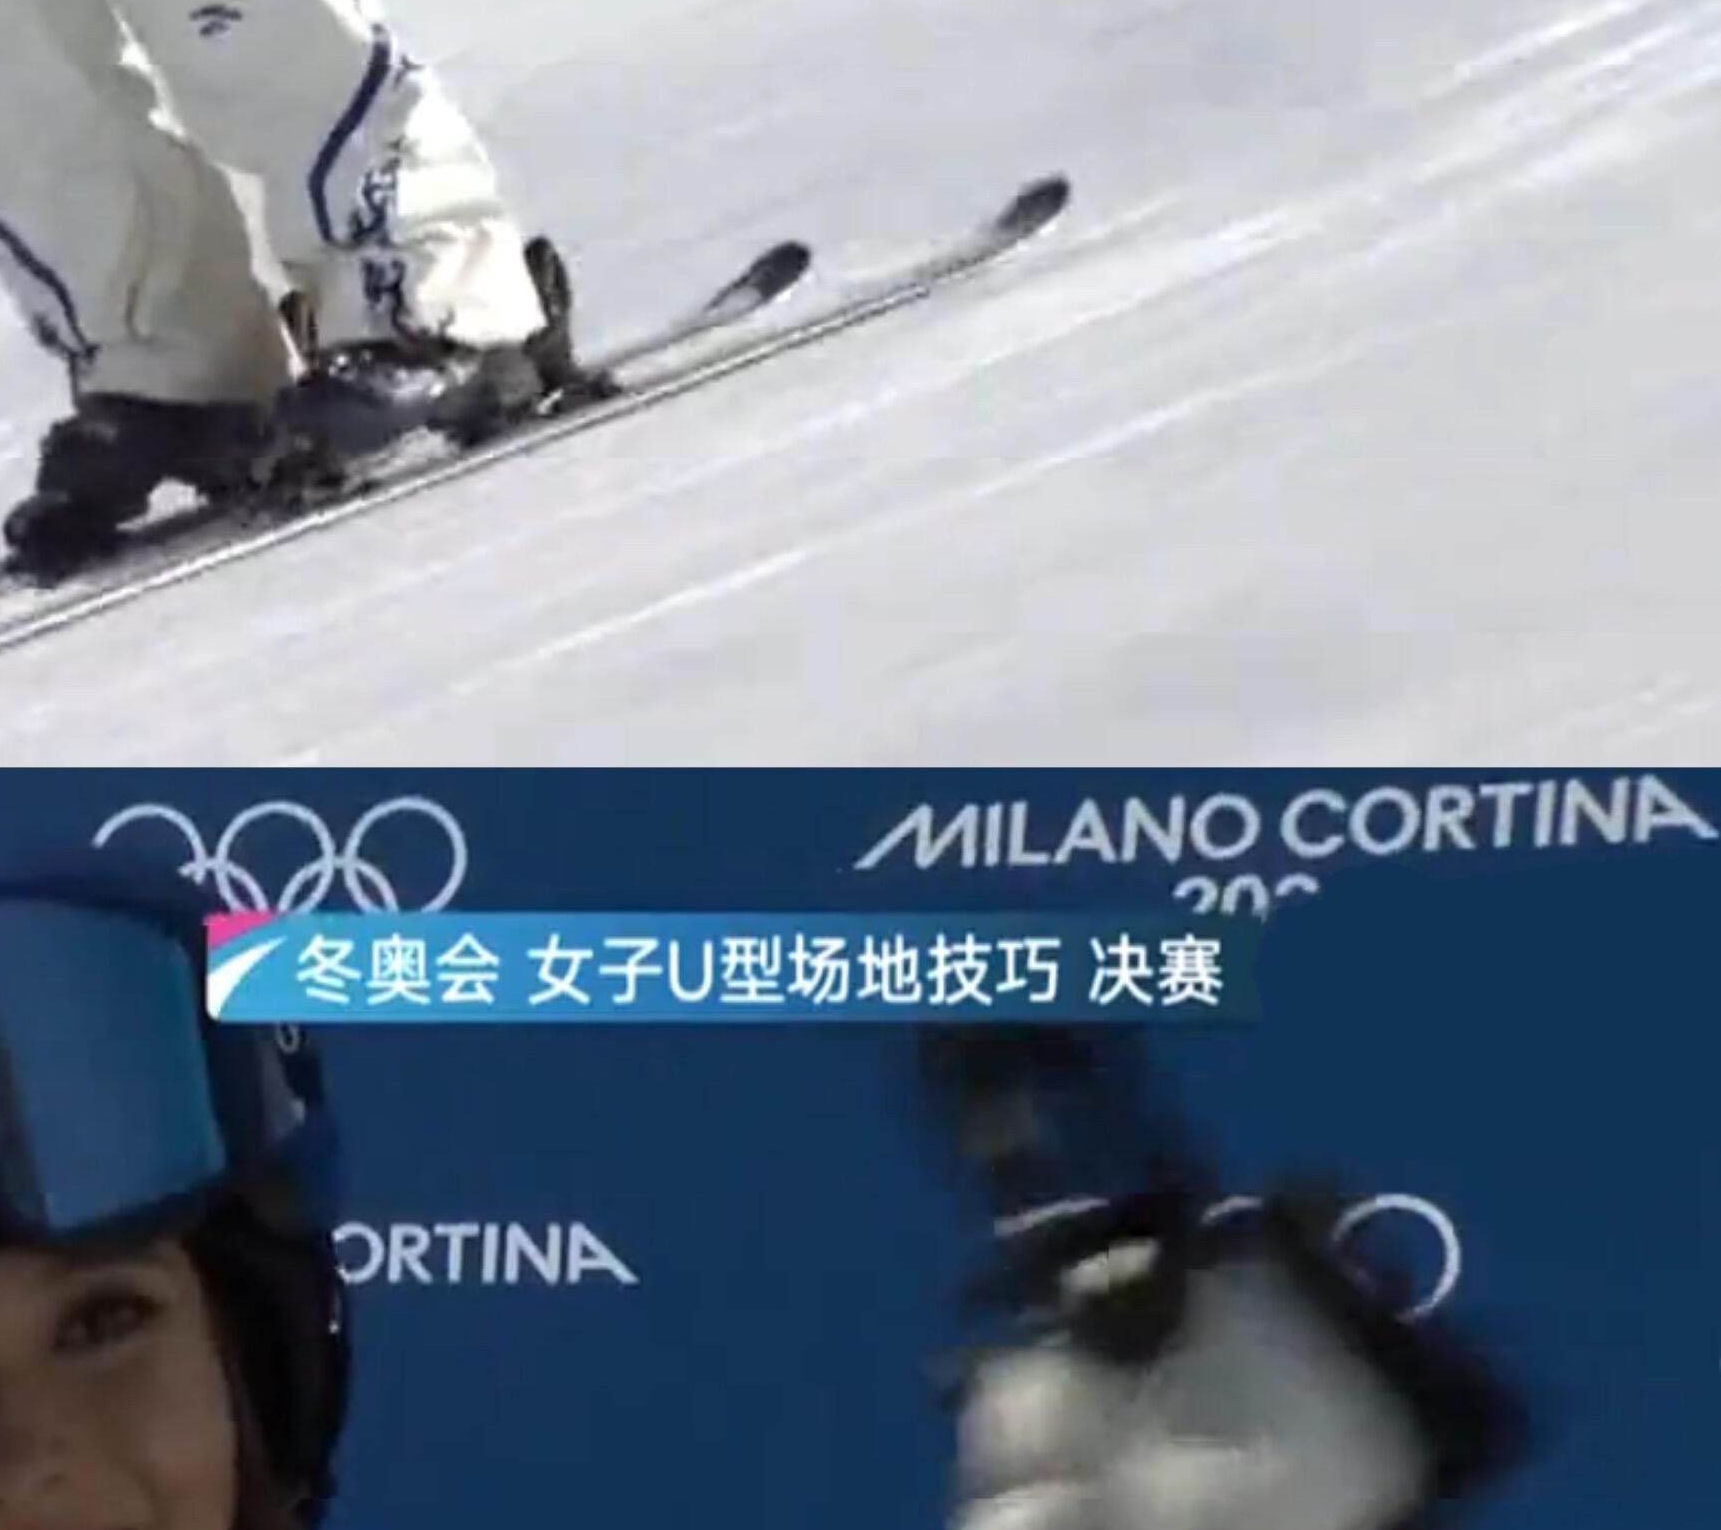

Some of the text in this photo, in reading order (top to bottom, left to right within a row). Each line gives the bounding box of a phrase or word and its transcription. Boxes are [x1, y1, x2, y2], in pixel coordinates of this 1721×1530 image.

[854, 774, 1719, 870] MILANO CORTINA
[332, 1221, 640, 1285] ORTINA
